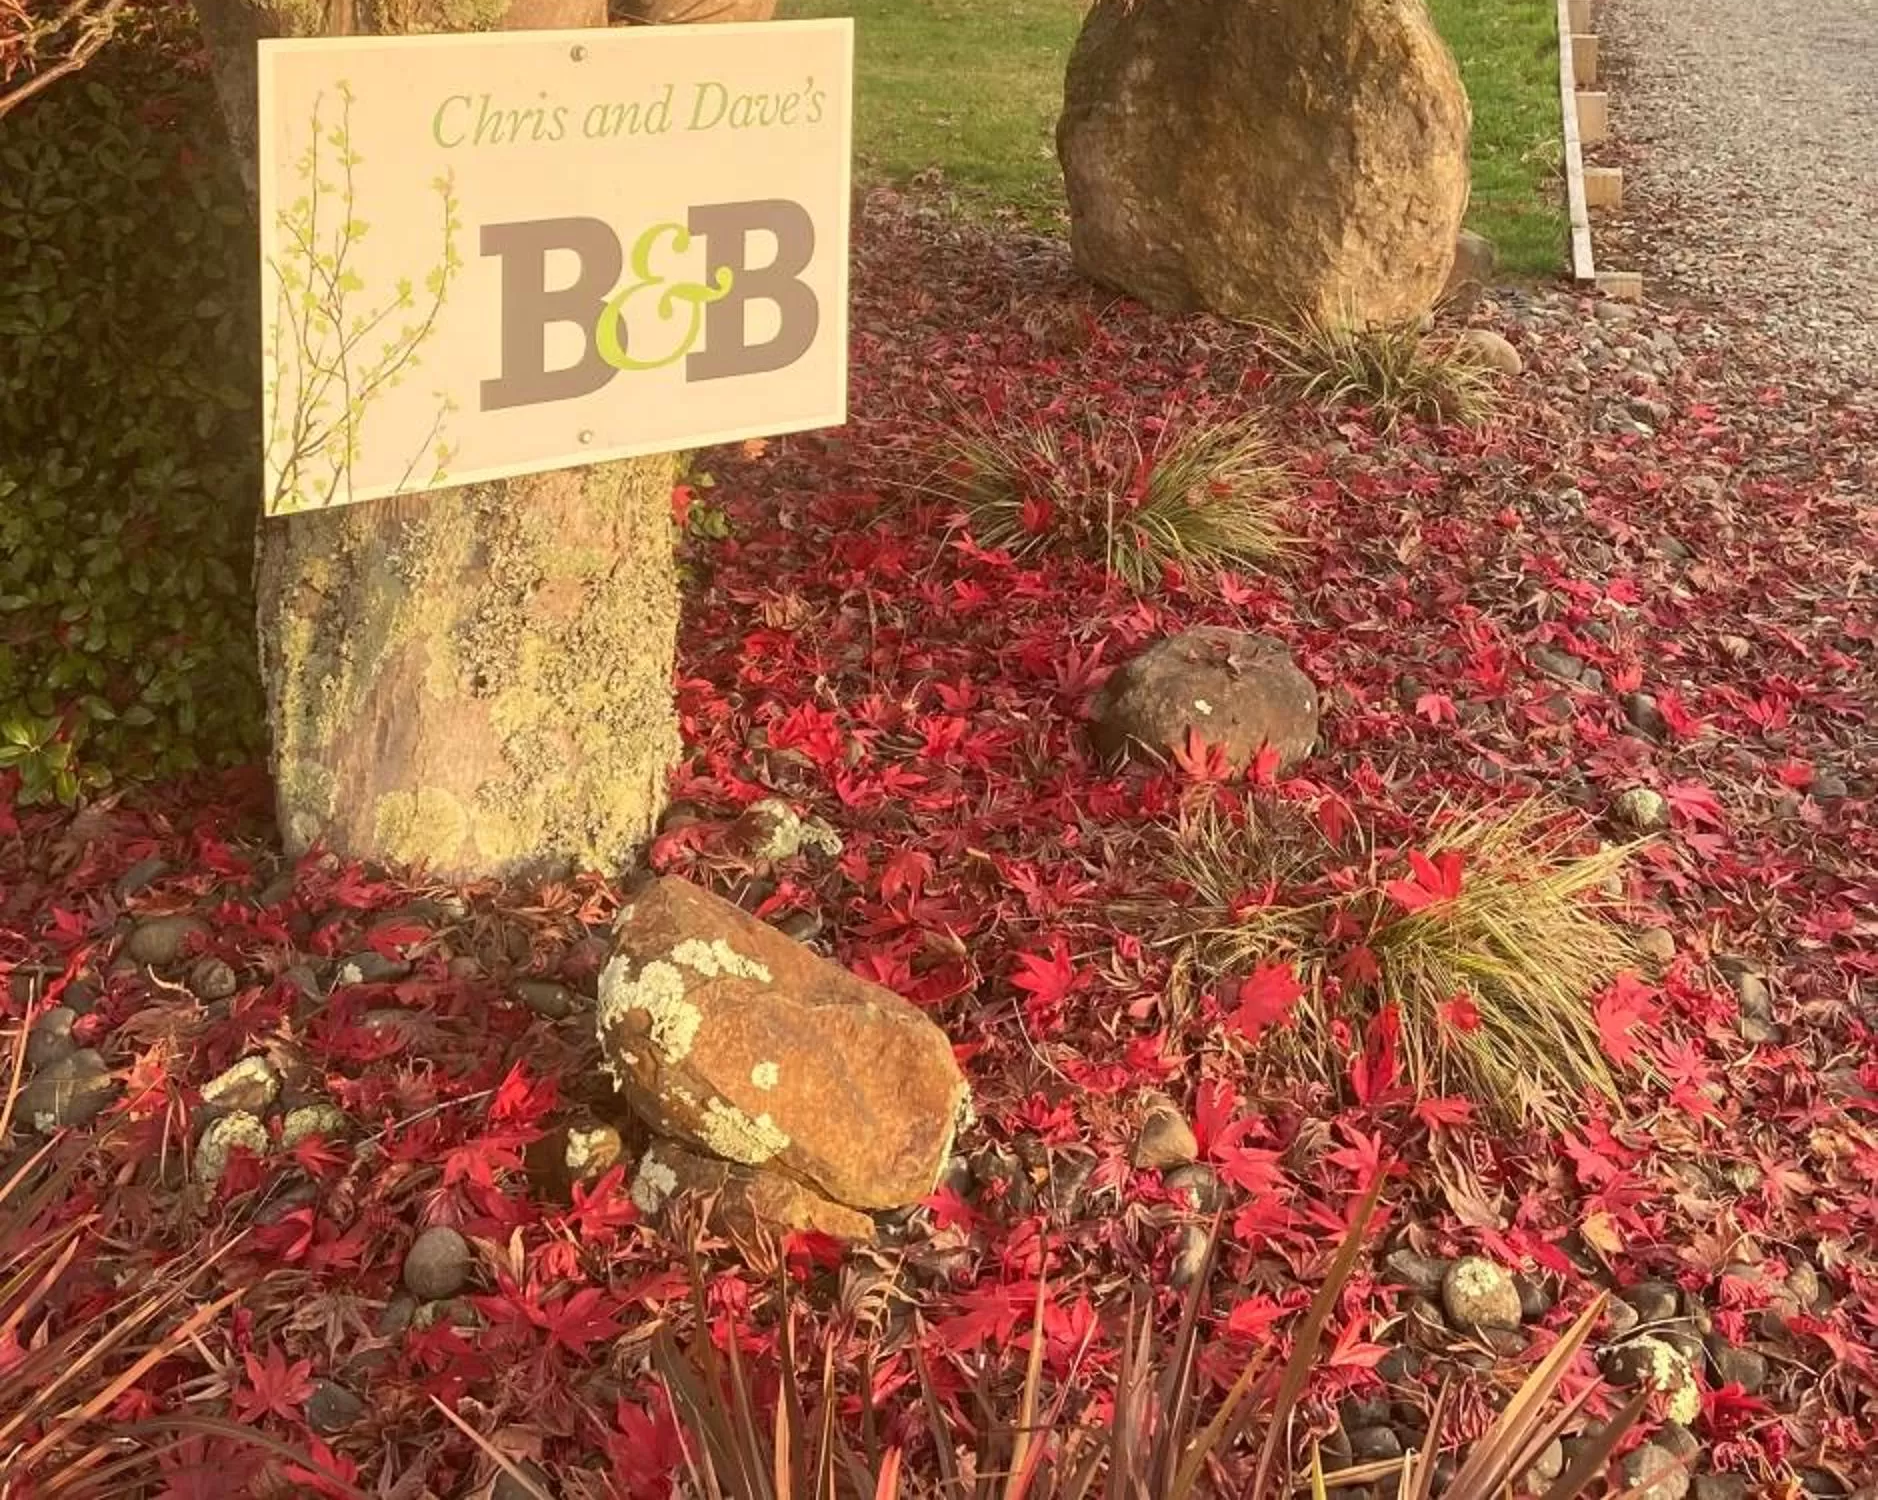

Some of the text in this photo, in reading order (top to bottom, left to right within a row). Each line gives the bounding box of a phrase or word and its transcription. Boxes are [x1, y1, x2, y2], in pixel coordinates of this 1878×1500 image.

[432, 76, 827, 149] Chris and Dave's
[480, 198, 820, 412] B&B
